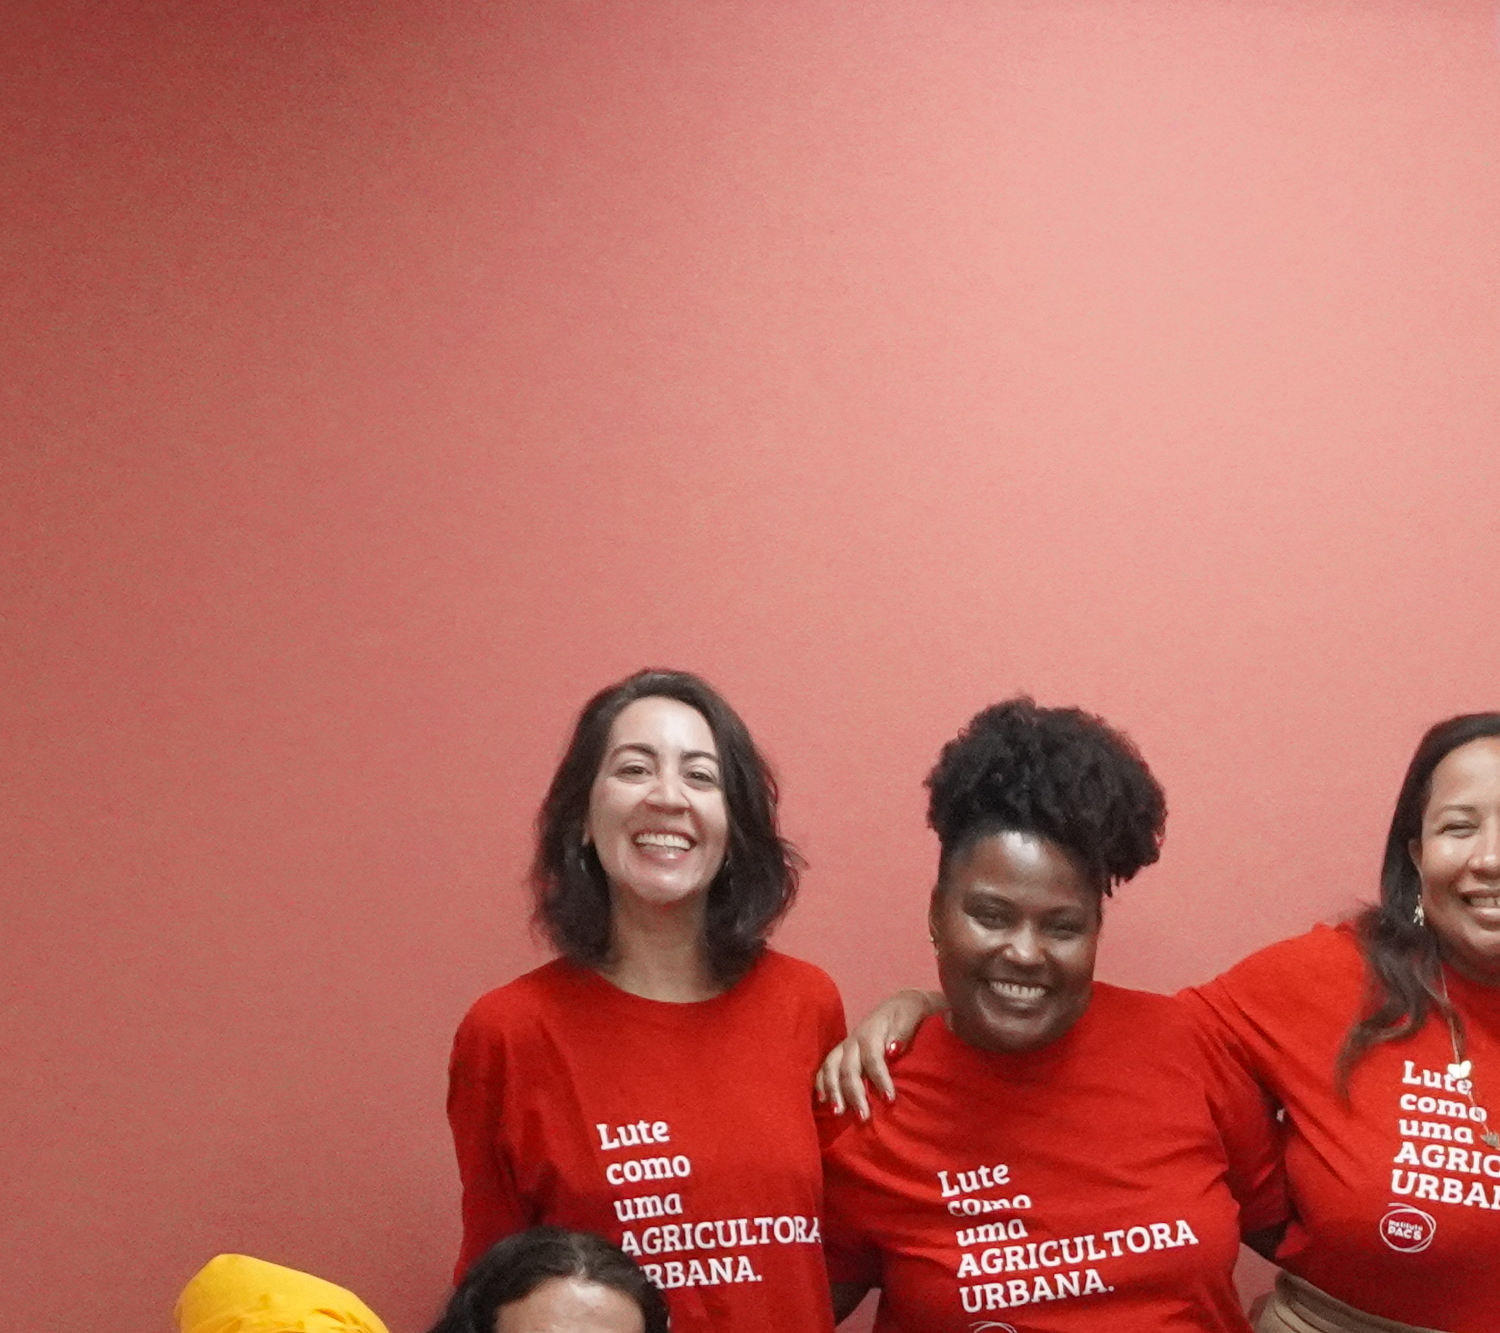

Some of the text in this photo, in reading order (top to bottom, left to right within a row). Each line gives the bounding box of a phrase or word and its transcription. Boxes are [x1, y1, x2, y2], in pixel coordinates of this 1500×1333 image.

[1402, 1060, 1473, 1095] Lute
[1399, 1093, 1487, 1123] como
[596, 1120, 670, 1150] Lute
[1398, 1118, 1475, 1145] uma
[606, 1155, 691, 1185] como
[937, 1163, 1010, 1197] Lute
[613, 1193, 683, 1222] uma
[955, 1218, 1028, 1247] uma
[956, 1220, 1199, 1279] AGRICULTORA
[639, 1256, 762, 1289] RBANA.
[959, 1269, 1115, 1313] URBANA.
